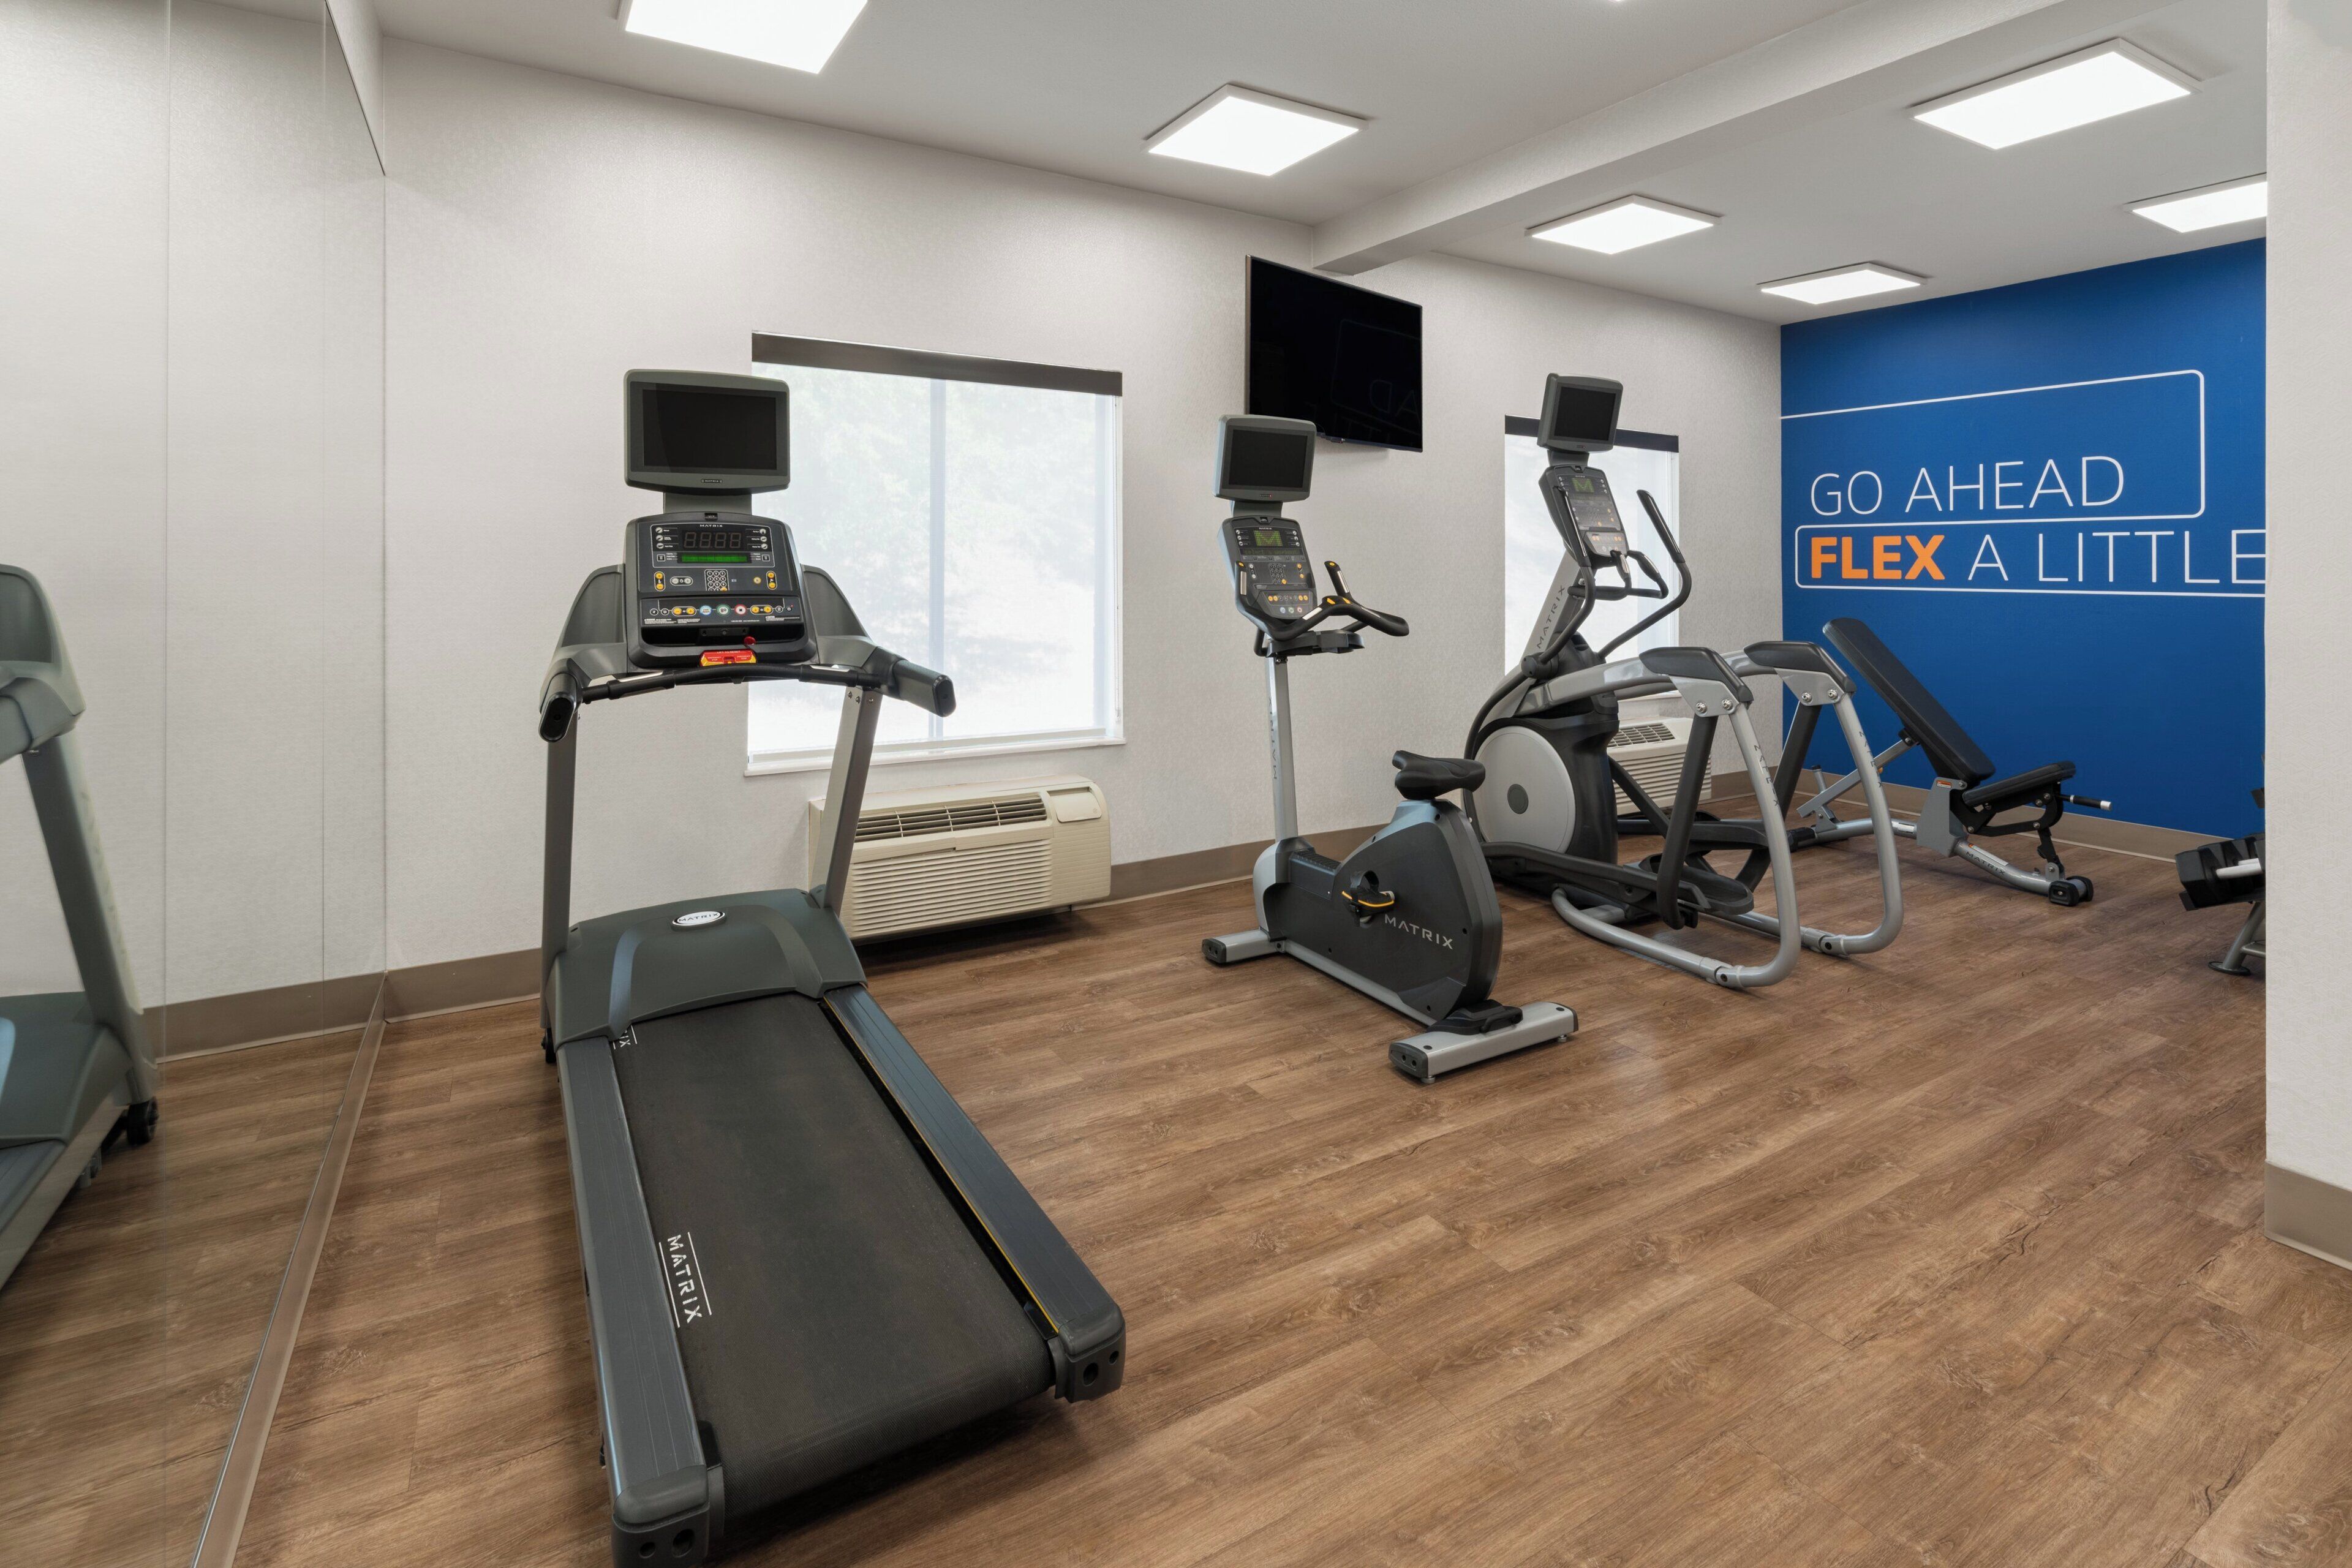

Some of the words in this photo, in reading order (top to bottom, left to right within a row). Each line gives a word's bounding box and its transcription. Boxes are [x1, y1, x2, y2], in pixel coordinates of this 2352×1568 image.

[1811, 470, 1883, 516] GO
[1905, 455, 2124, 513] AHEAD
[1811, 535, 1945, 580] FLEX
[1967, 534, 2009, 581] A
[2038, 529, 2265, 584] LITTLE
[1536, 585, 1566, 649] MATRIX
[1966, 851, 2006, 876] MATRIX
[679, 913, 719, 922] MATRIX
[1384, 913, 1453, 950] MATRIX
[667, 1234, 703, 1324] MATRIX
